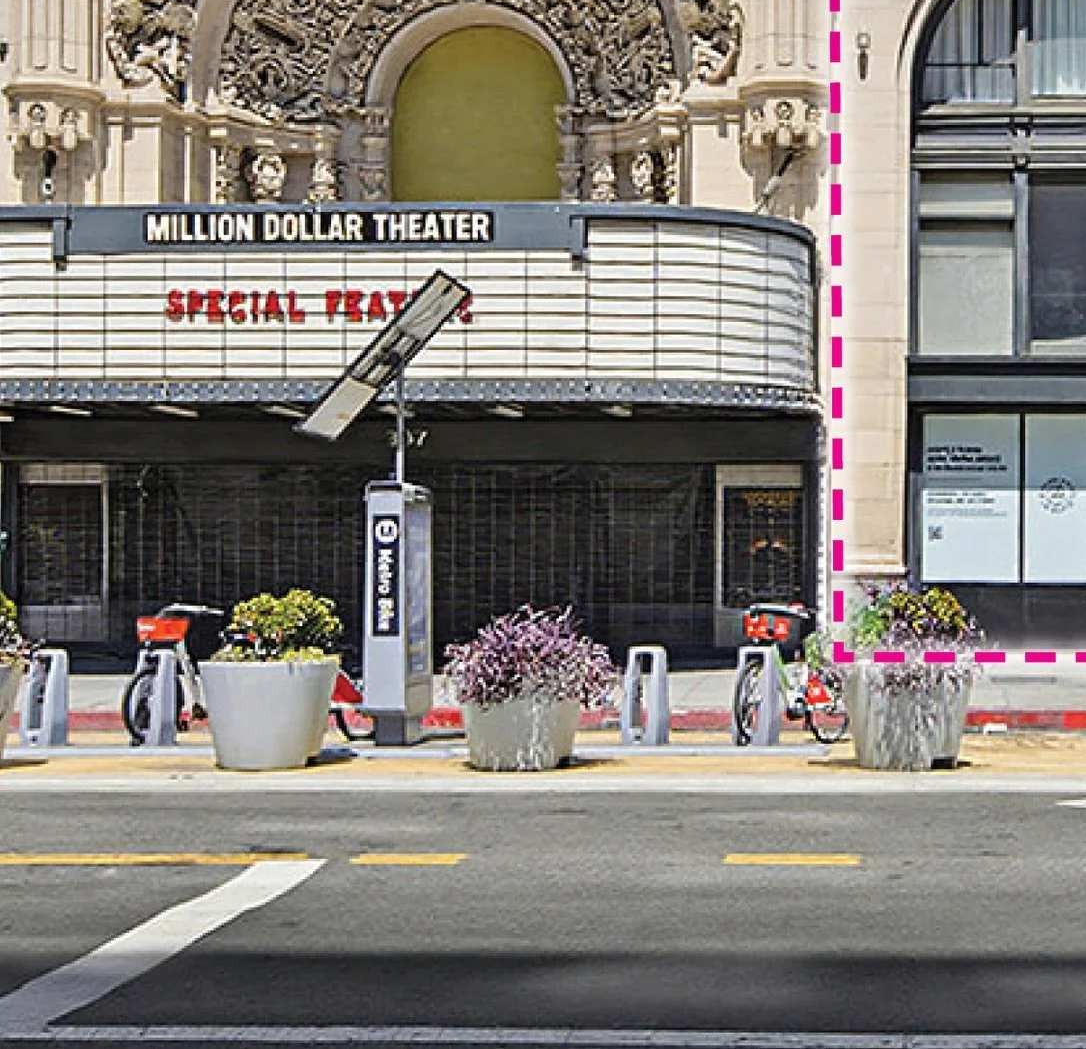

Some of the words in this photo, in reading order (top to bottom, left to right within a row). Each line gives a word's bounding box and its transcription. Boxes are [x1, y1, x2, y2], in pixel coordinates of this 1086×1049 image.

[146, 213, 254, 242] MILLION
[263, 213, 363, 242] DOLLAR
[373, 213, 491, 242] THEATER
[165, 289, 306, 324] SPECIAL
